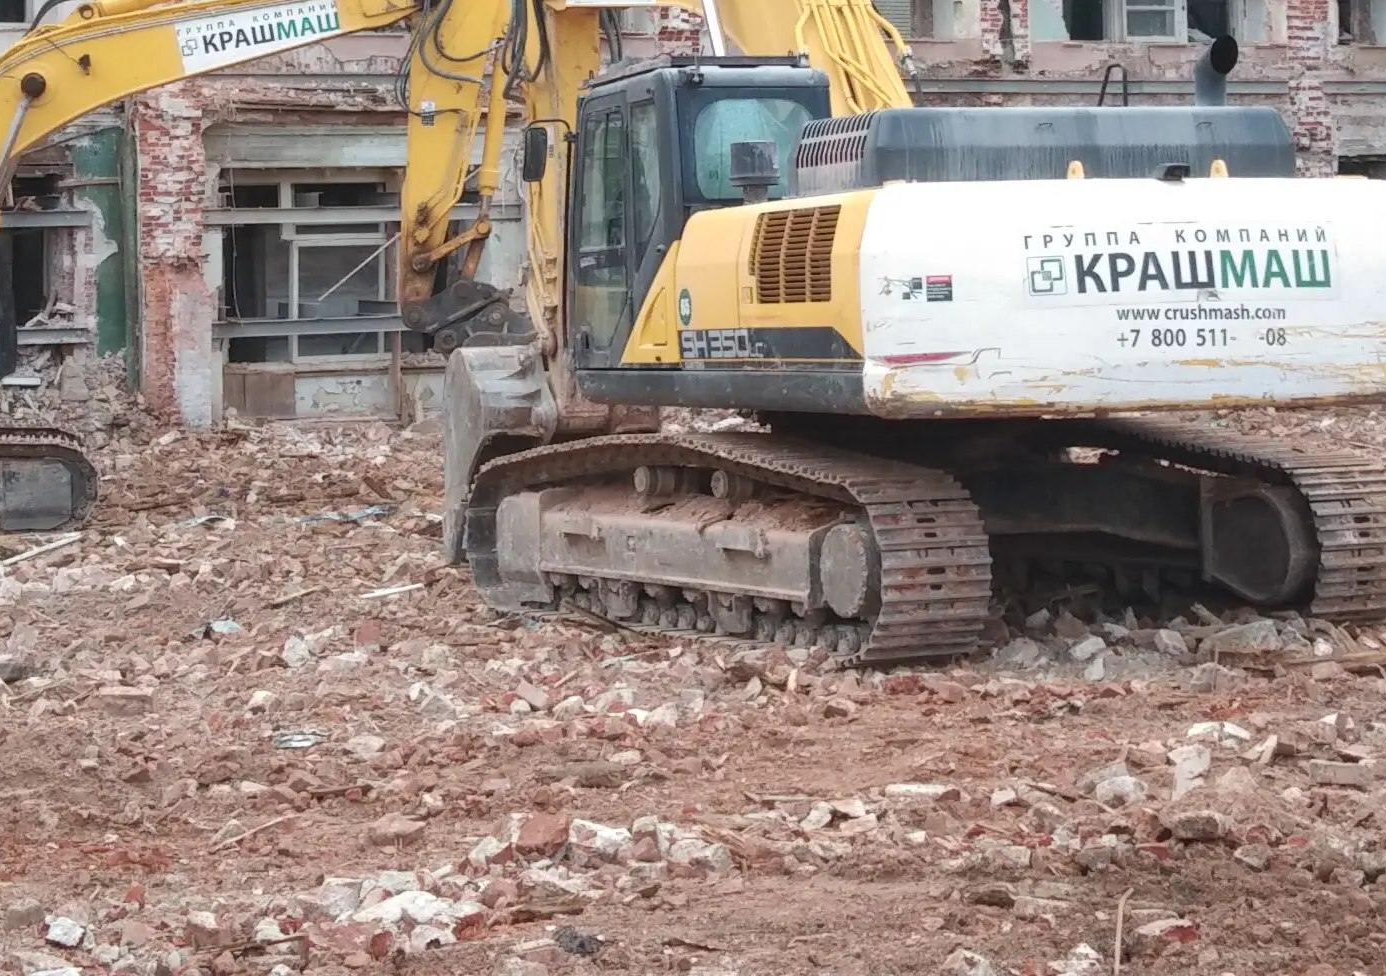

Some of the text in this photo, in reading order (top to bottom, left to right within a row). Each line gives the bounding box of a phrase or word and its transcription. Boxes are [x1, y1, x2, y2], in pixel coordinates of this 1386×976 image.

[177, 1, 338, 36] ГРУППА КОМПАНИЙ
[202, 12, 340, 53] КРАШМАШ
[1024, 225, 1328, 250] ГРУППА КОМПАНИЙ
[1074, 249, 1331, 294] КРАШМАШ
[708, 329, 750, 358] 350
[1117, 329, 1140, 347] +7
[1151, 328, 1186, 347] 800
